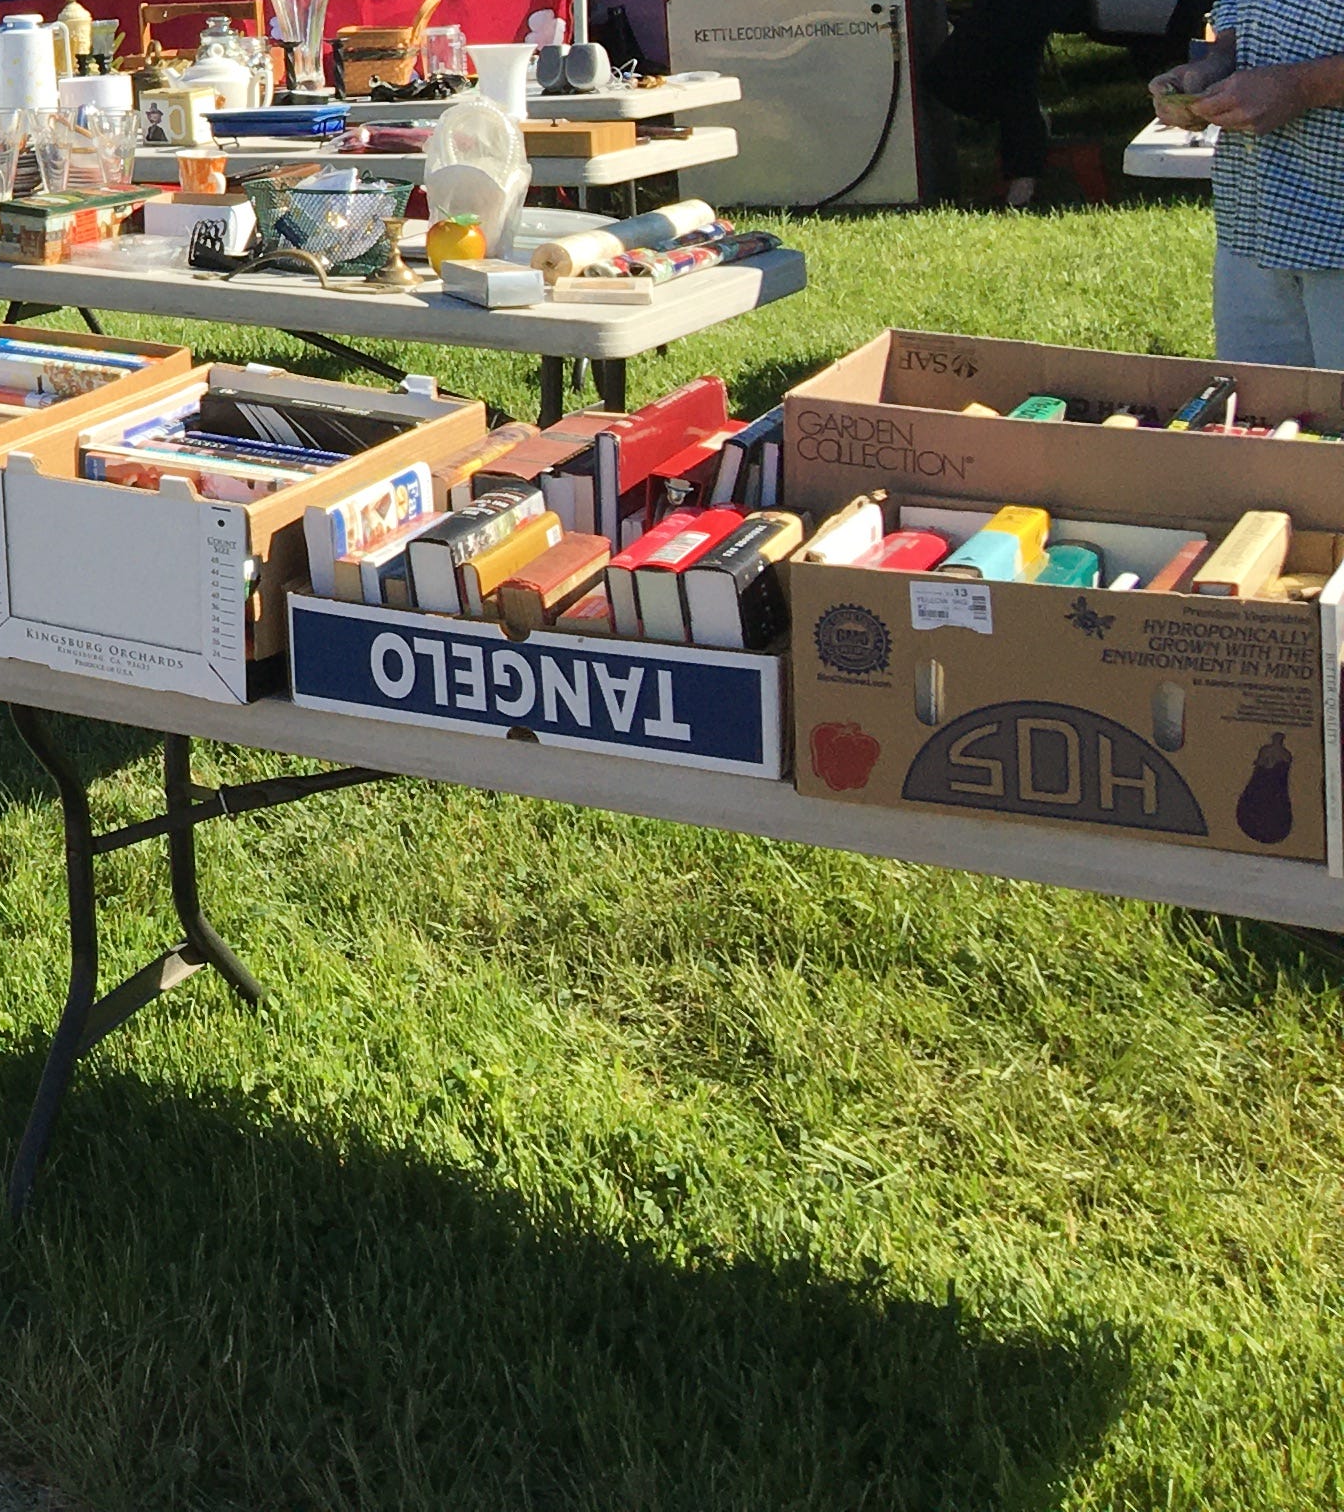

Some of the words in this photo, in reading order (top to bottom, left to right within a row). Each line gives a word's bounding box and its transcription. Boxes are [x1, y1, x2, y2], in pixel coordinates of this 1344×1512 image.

[694, 21, 880, 43] KETTLECORNMACHINE.COM
[898, 351, 948, 375] SAF
[797, 410, 914, 448] GARDEN
[25, 627, 103, 654] KINGSBURG
[108, 645, 185, 670] ORCHARDS
[1143, 618, 1313, 646] HYDROPONICALLY
[1148, 637, 1219, 657] GROWN
[1225, 641, 1271, 660] WITH
[1277, 646, 1313, 664] THE
[1101, 648, 1236, 672] ENVIRONMENT
[1239, 659, 1259, 676] IN
[1264, 664, 1314, 680] MIND
[1325, 652, 1338, 694] BETTER
[370, 631, 692, 743] TANGELO
[1325, 698, 1339, 746] QUALITY
[948, 717, 1158, 816] SDH
